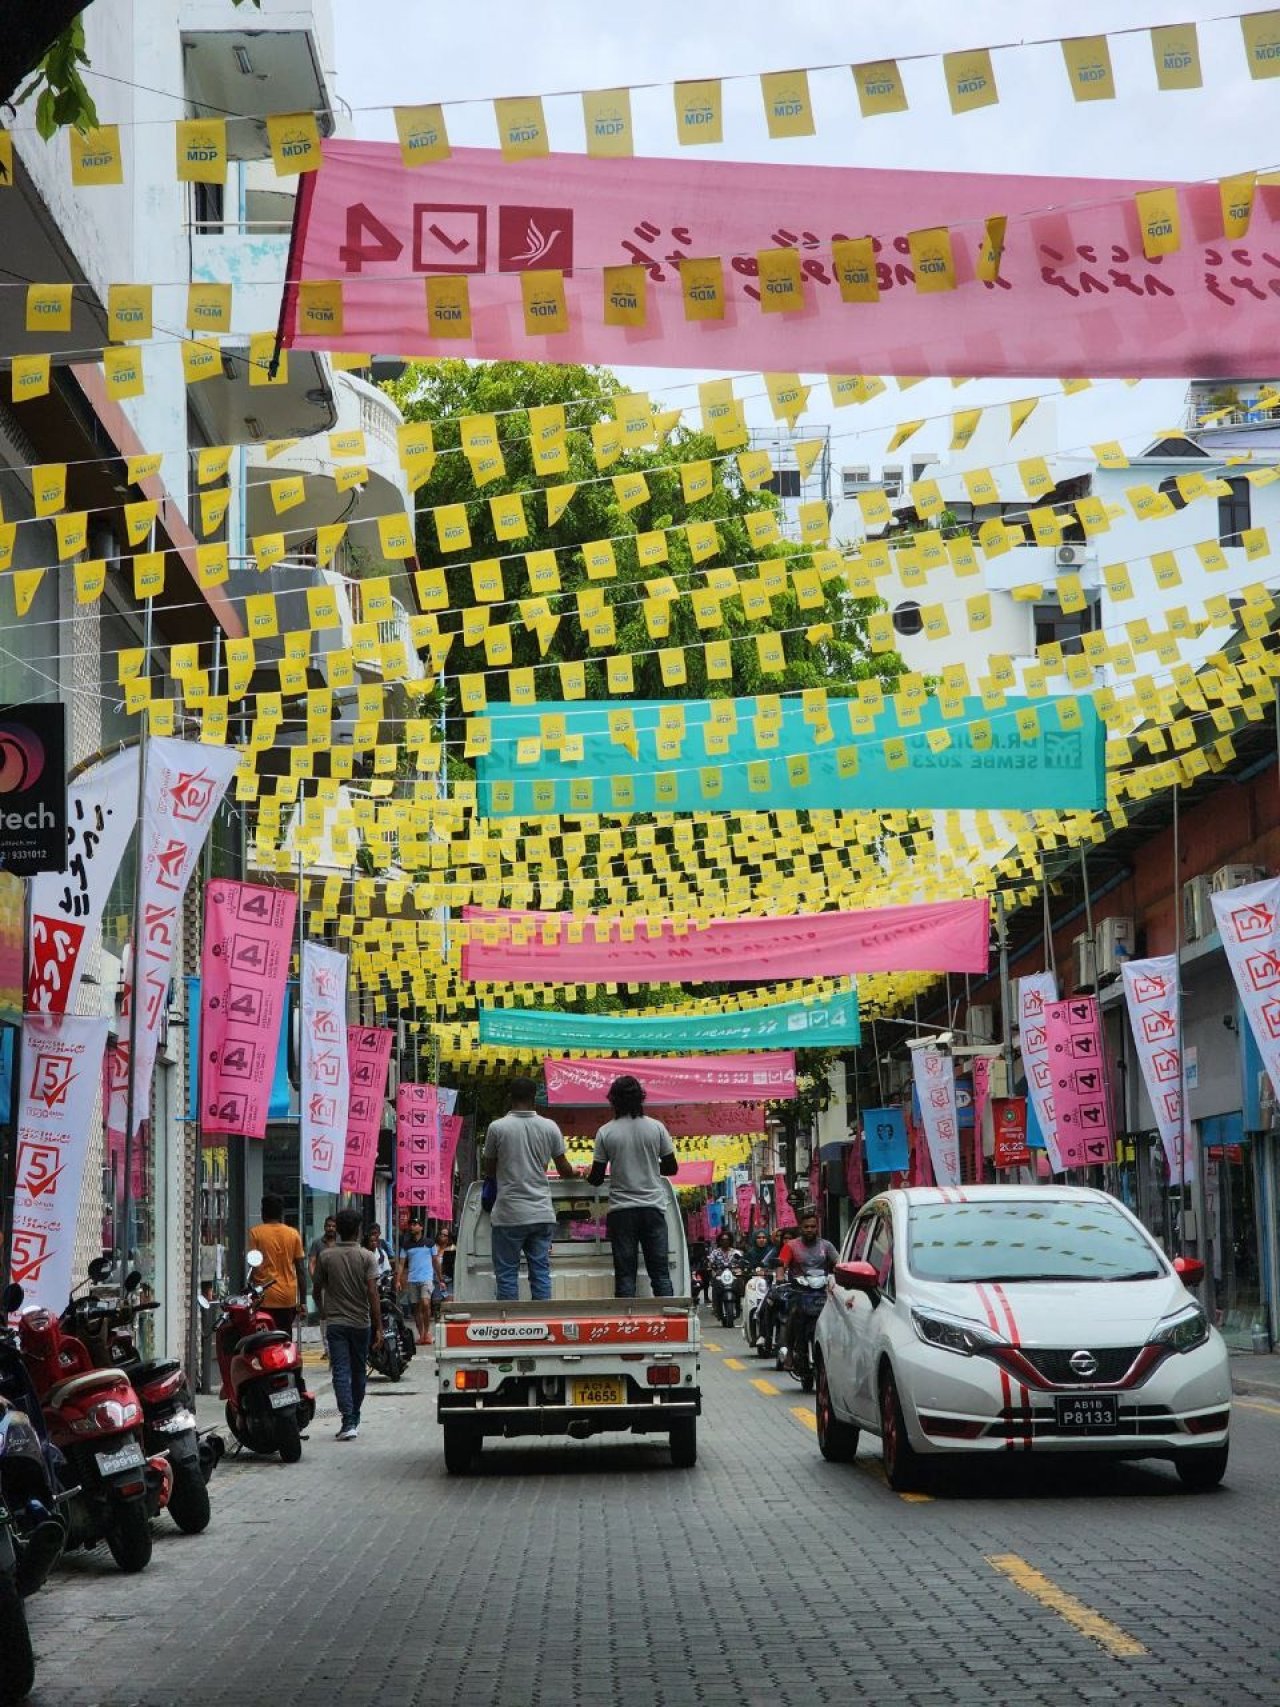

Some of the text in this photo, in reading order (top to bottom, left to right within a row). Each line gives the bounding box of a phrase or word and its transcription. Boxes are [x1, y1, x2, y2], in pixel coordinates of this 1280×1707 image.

[1164, 57, 1192, 68] MDP
[1079, 70, 1105, 82] MDP
[866, 84, 894, 96] MDP
[957, 80, 987, 94] MDP
[774, 105, 803, 117] MDP
[685, 113, 713, 125] MDP
[510, 130, 539, 143] MDP
[595, 123, 624, 136] MDP
[409, 136, 437, 150] MDP
[187, 151, 218, 161] MDP
[282, 144, 312, 157] MDP
[82, 156, 112, 168] MDP
[837, 382, 858, 392] MDP
[777, 393, 798, 402] MDP
[42, 491, 61, 501] MDP
[84, 579, 101, 589] MDP
[141, 576, 160, 585] MDP
[243, 895, 268, 917] 4
[237, 945, 262, 966] 4
[231, 994, 256, 1016] 4
[1072, 1004, 1088, 1019] 4
[363, 1033, 376, 1048] 4
[1076, 1038, 1092, 1052] 4
[224, 1048, 247, 1070] 4
[44, 1062, 60, 1090] 5
[357, 1067, 369, 1081] 4
[1080, 1073, 1096, 1088] 4
[219, 1100, 239, 1123] 4
[352, 1100, 365, 1114] 4
[1084, 1107, 1100, 1122] 4
[347, 1136, 360, 1150] 4
[1088, 1142, 1105, 1156] 4
[28, 1152, 48, 1178] 5
[344, 1171, 356, 1184] 4
[12, 1239, 30, 1266] 5
[472, 1326, 544, 1339] veligaa.com
[1064, 1411, 1112, 1424] P8133
